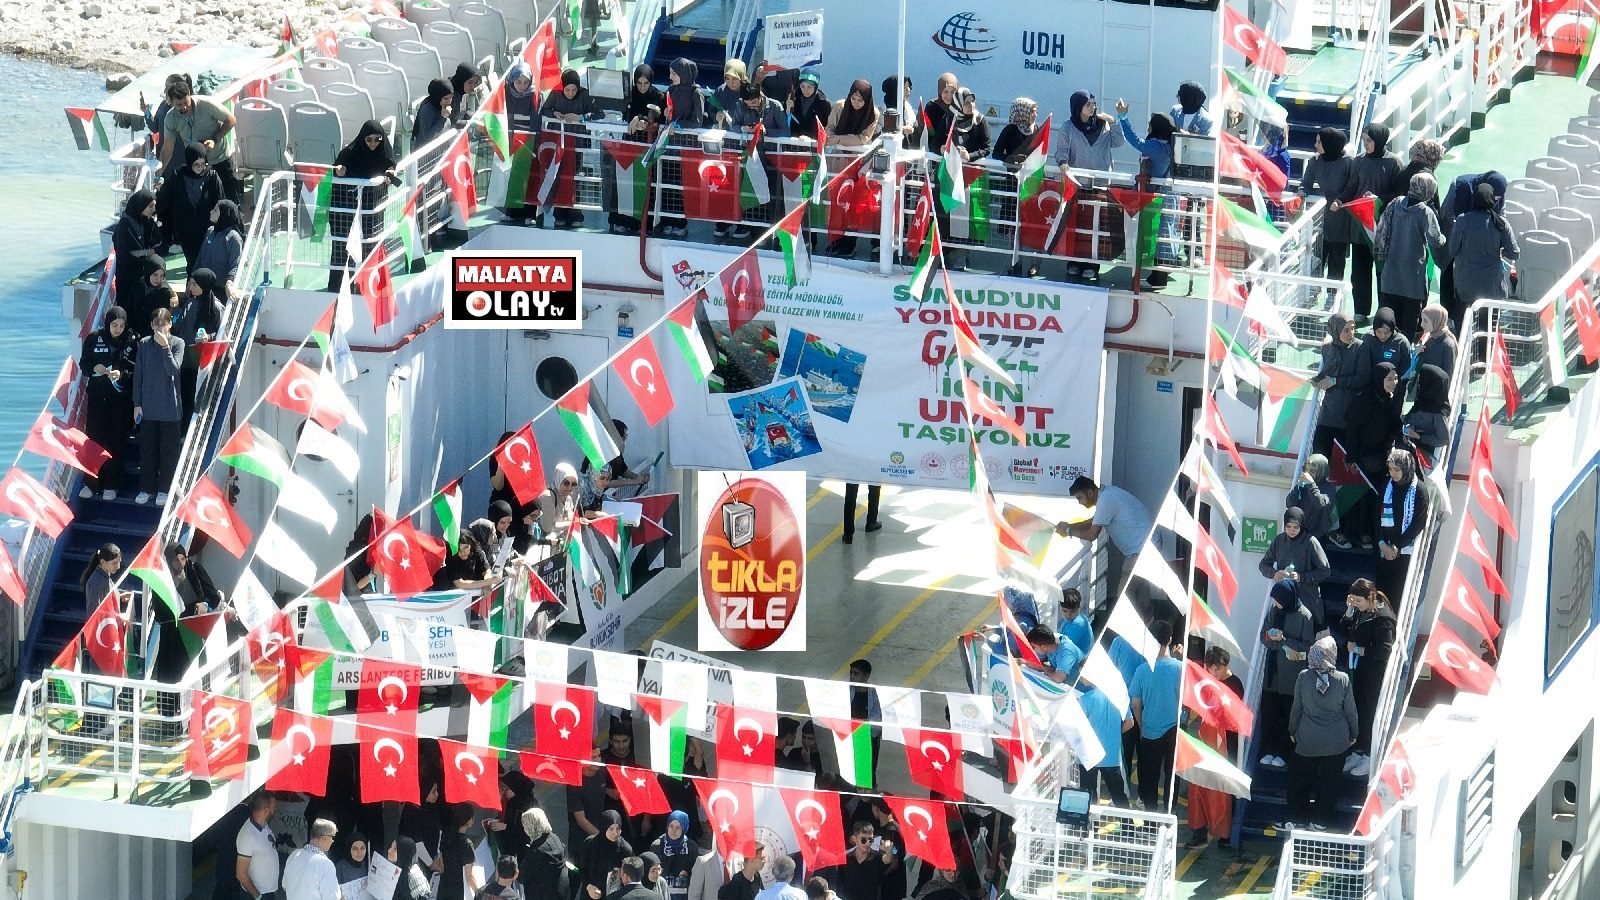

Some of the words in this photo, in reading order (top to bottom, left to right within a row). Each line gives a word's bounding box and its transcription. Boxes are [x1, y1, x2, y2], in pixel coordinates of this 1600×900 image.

[1022, 30, 1065, 59] UDH
[1024, 58, 1064, 75] Bakanlığı
[822, 311, 857, 322] YANINDA
[894, 306, 1064, 334] YOLUNDA
[897, 422, 1071, 449] TAŞIYORUZ
[1013, 458, 1033, 467] Global
